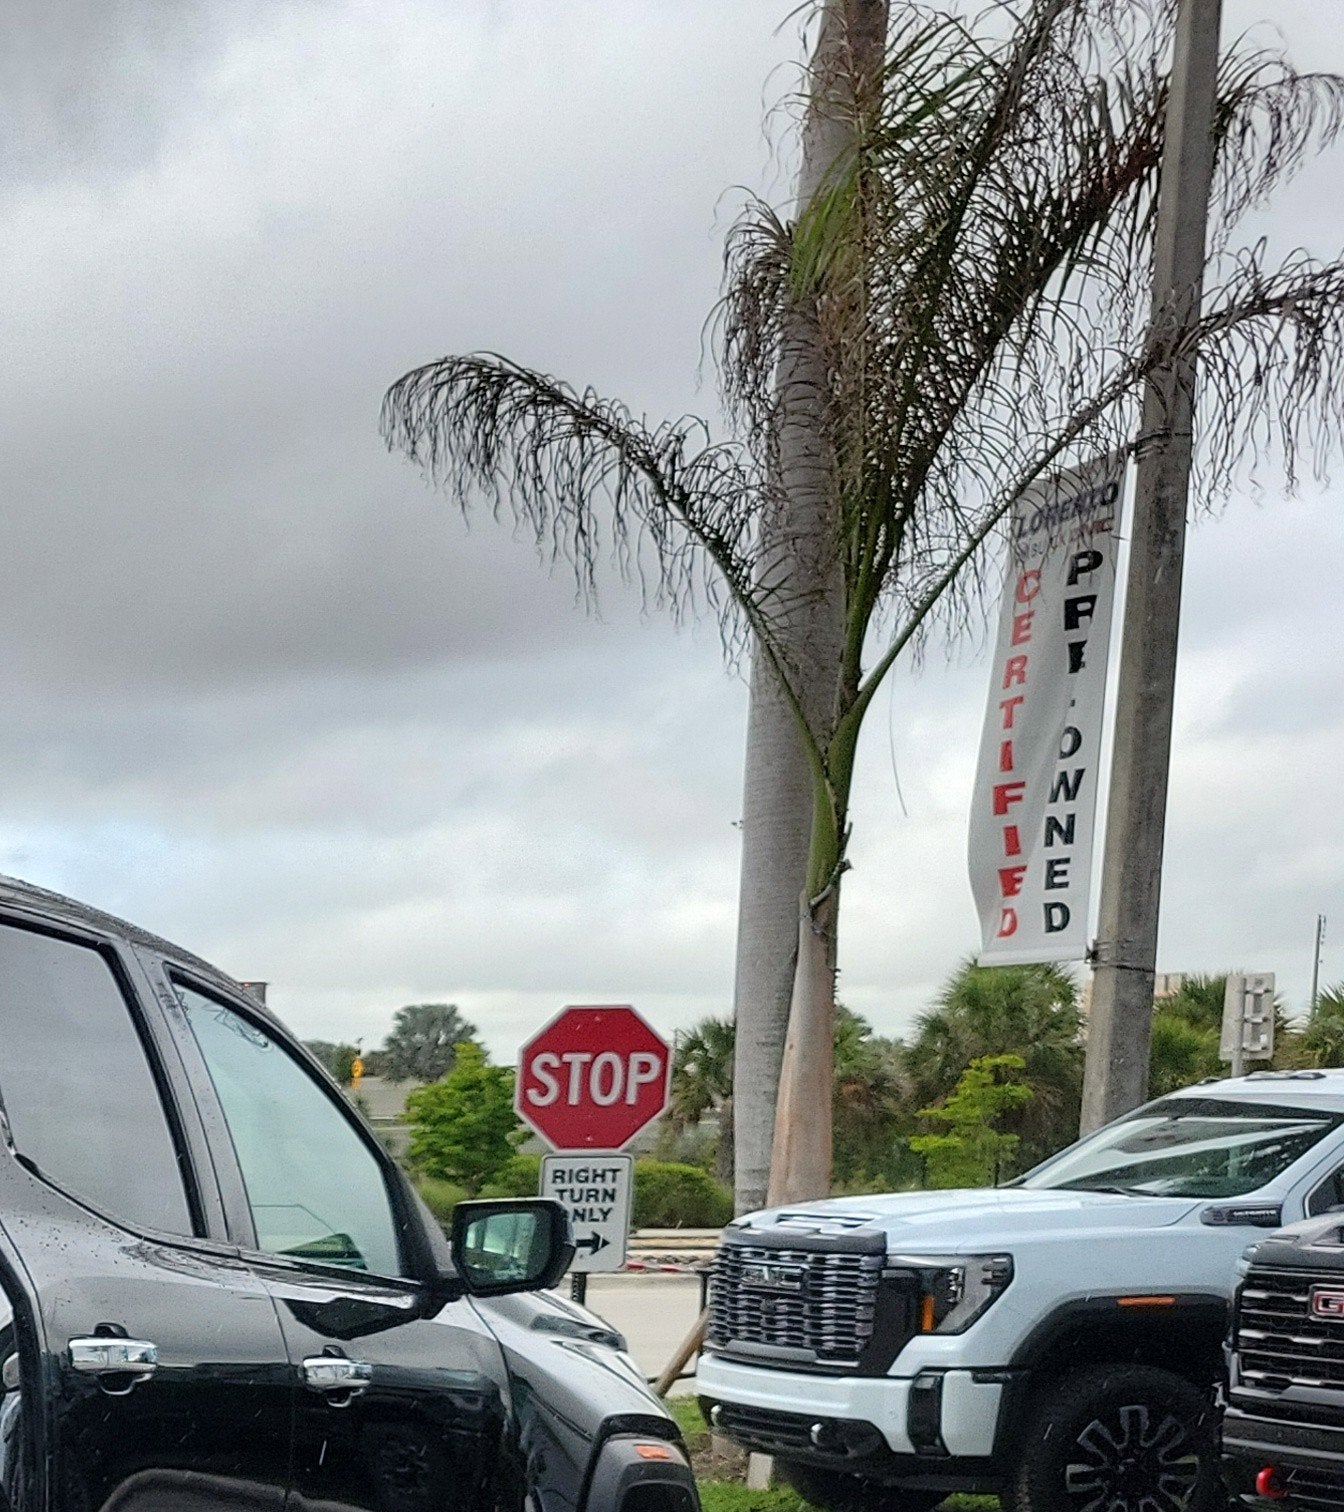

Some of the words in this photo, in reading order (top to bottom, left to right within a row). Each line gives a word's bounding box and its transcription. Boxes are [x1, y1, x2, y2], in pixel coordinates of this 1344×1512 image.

[993, 568, 1043, 938] CERTIFIED
[526, 1051, 662, 1107] STOP
[552, 1167, 622, 1184] RIGHT
[555, 1187, 616, 1203] TURN
[570, 1206, 612, 1222] NLY
